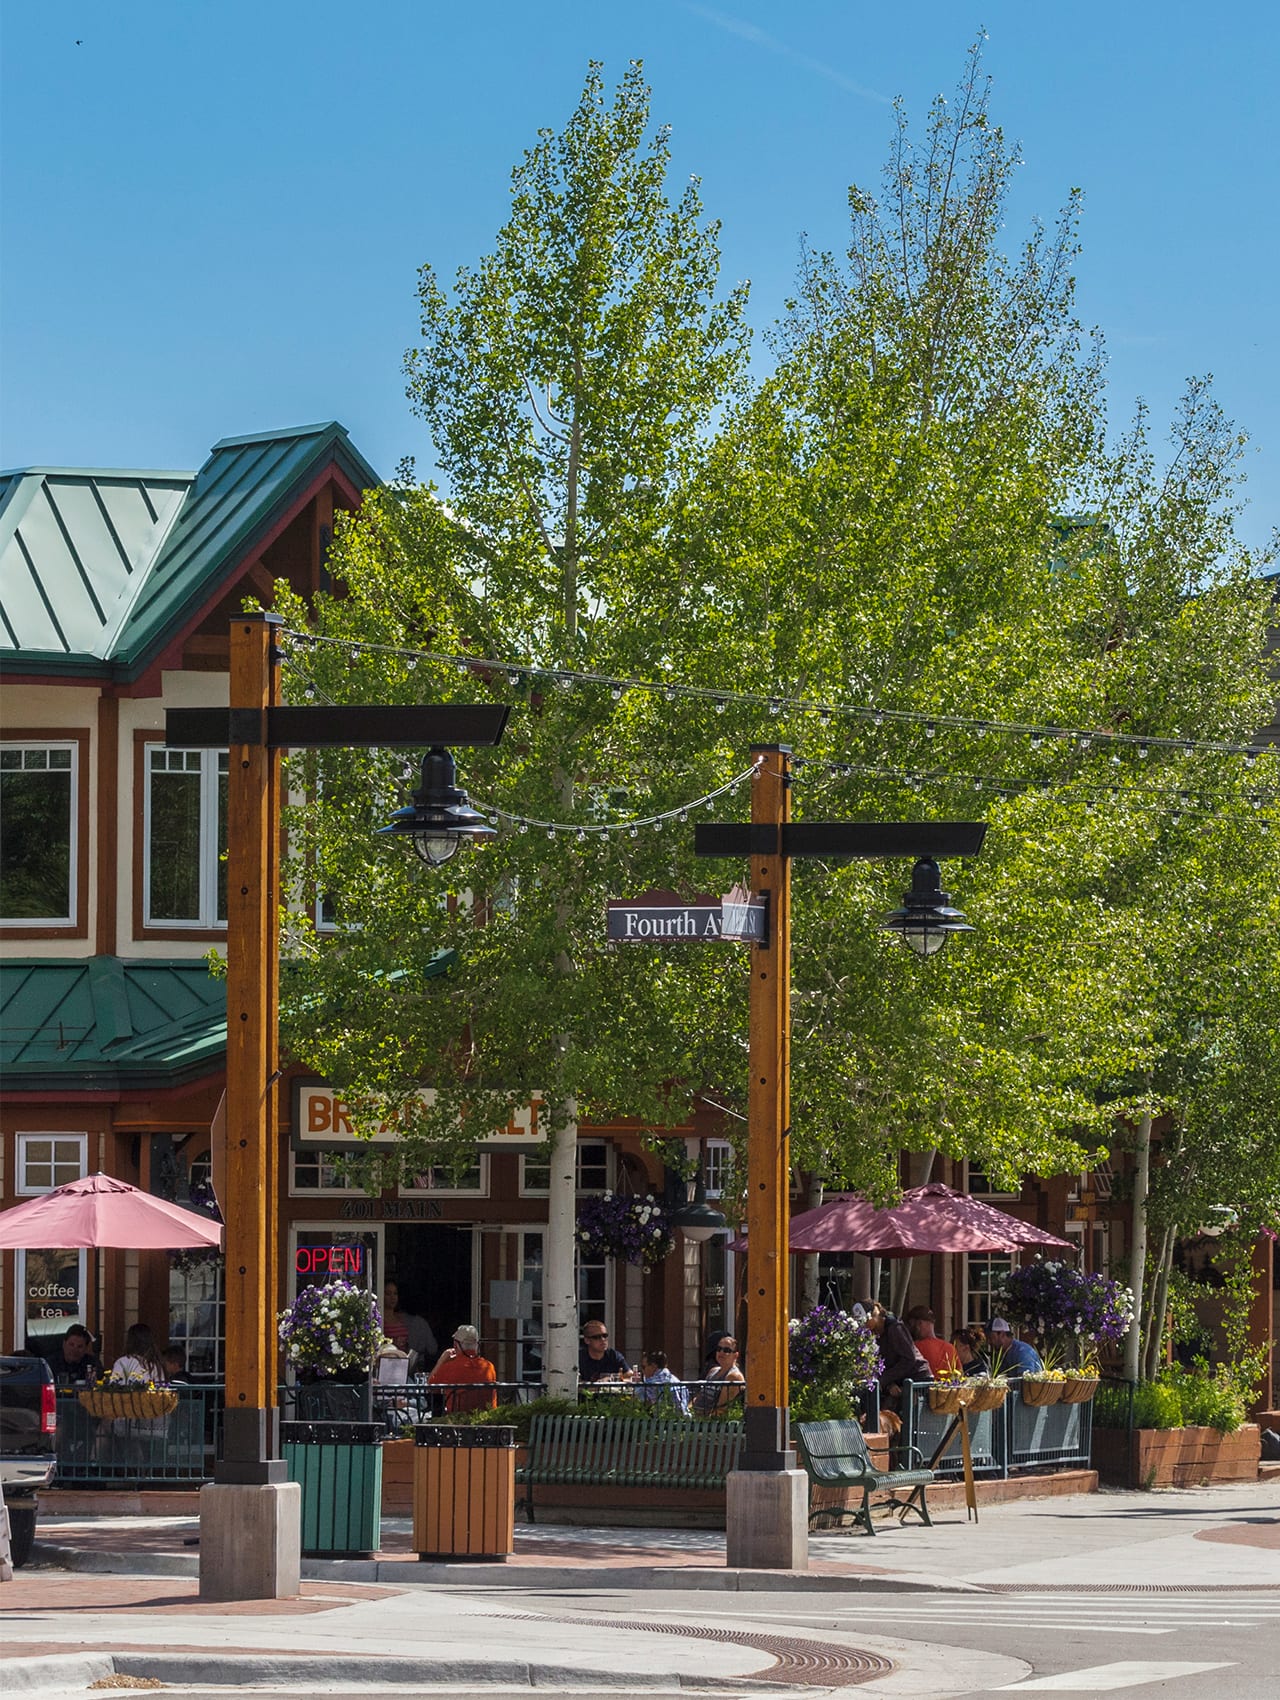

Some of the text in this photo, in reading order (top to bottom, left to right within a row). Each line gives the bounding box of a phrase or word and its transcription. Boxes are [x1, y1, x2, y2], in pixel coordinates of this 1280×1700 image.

[624, 910, 698, 937] Fourth
[340, 1201, 443, 1218] 401 MAIN
[295, 1247, 361, 1273] OPEN
[28, 1283, 76, 1298] coffee
[40, 1307, 63, 1319] tea
